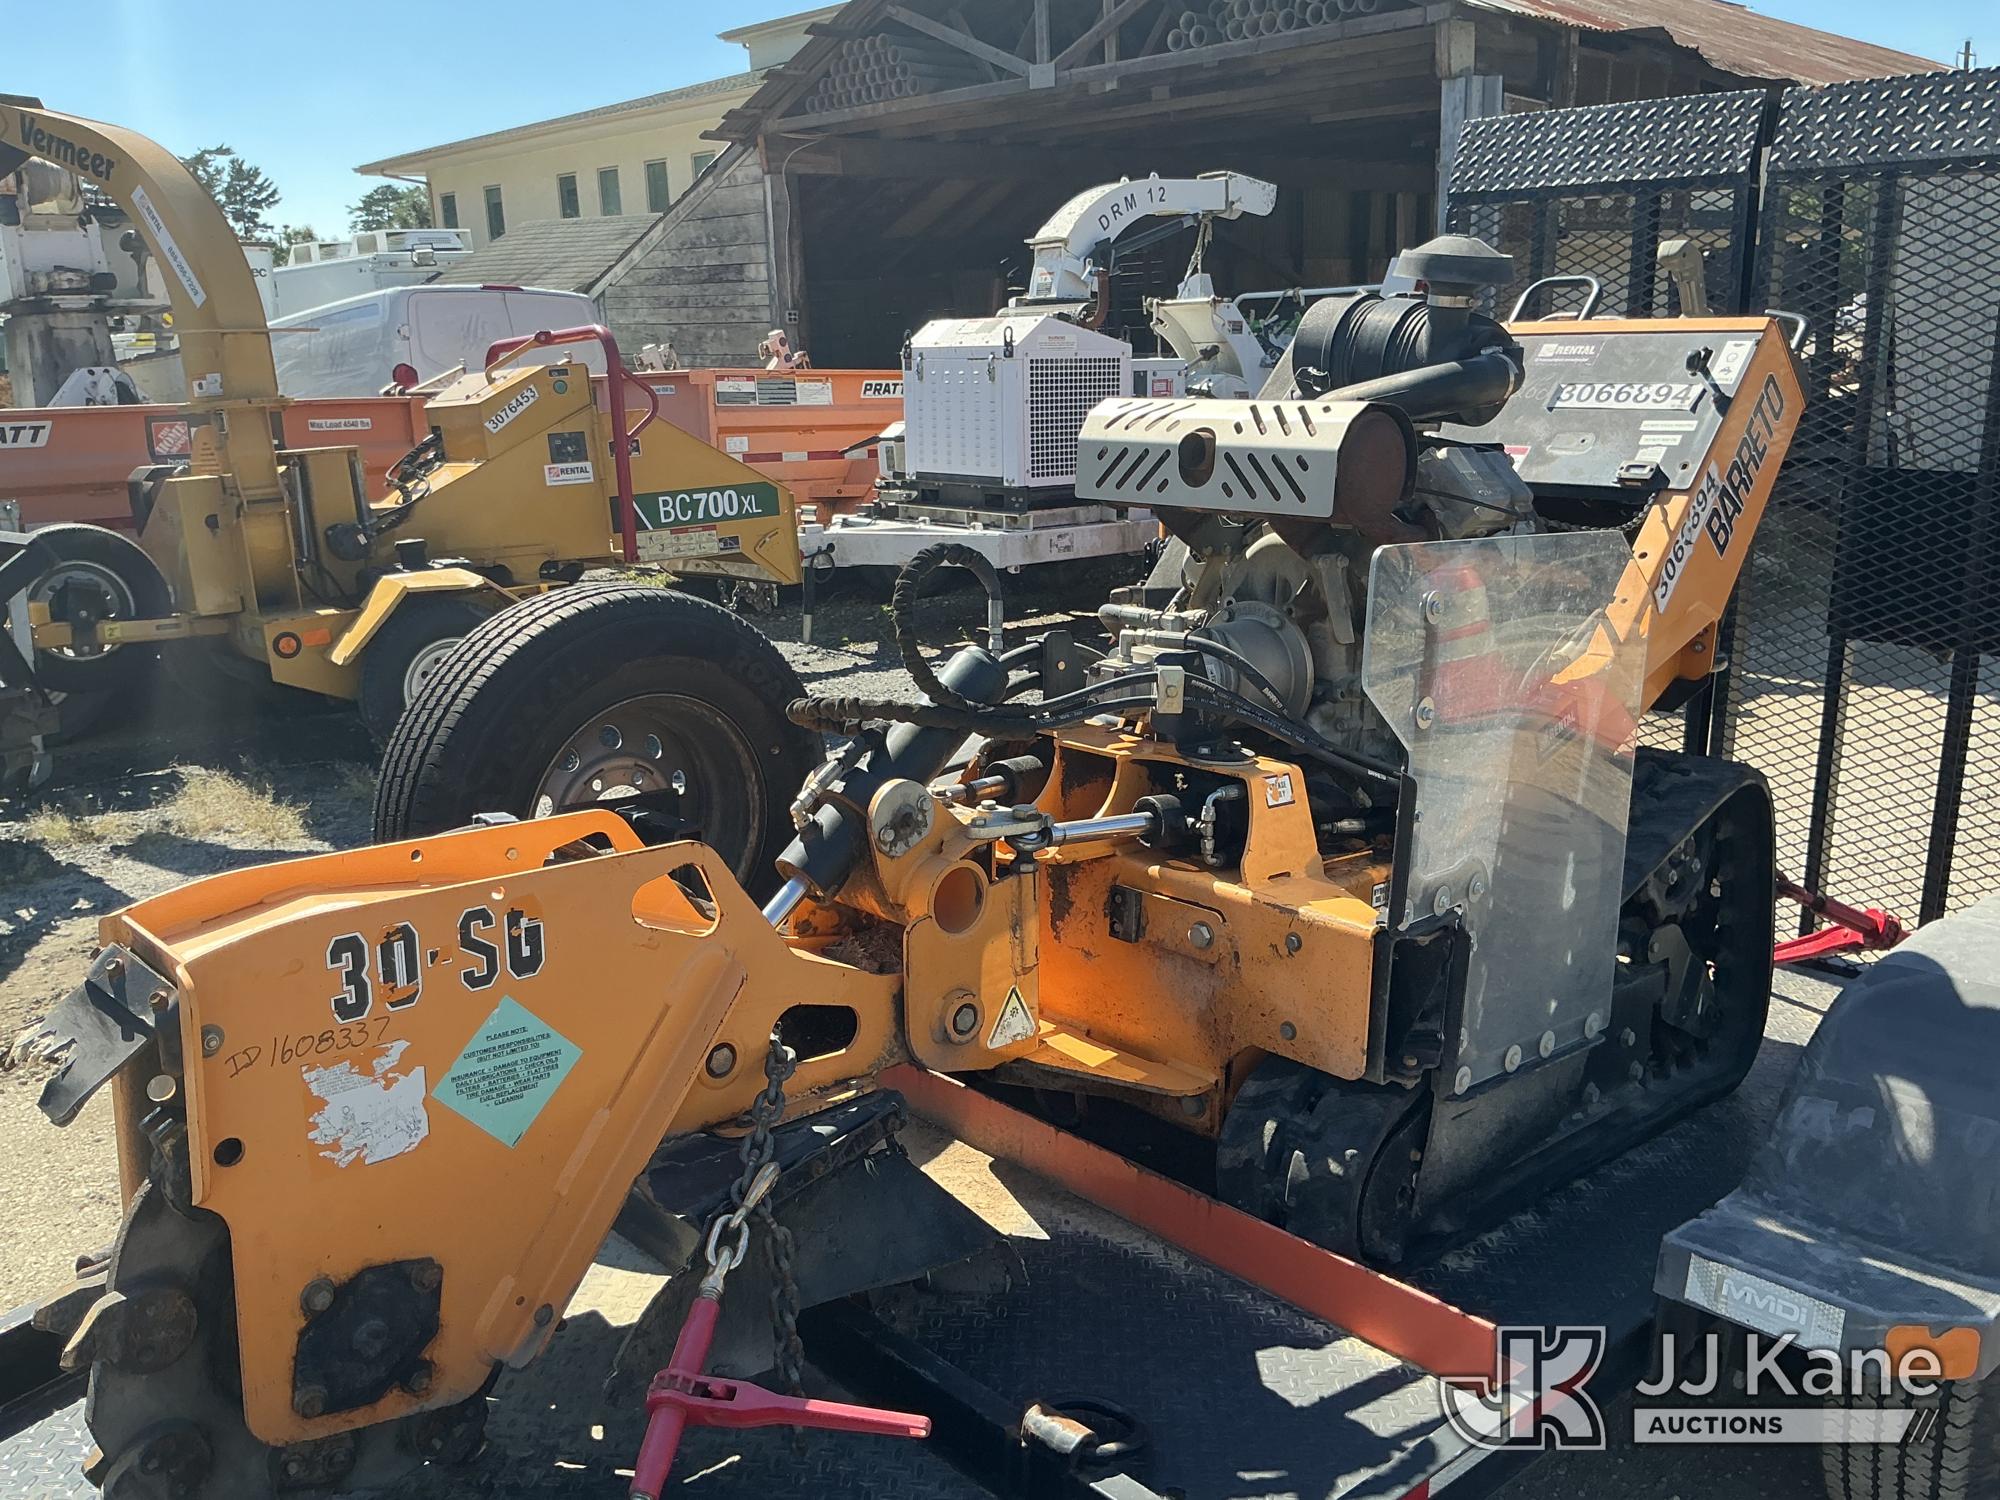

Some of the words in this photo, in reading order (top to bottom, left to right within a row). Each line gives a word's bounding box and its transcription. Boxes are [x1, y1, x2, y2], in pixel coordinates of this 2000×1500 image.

[19, 112, 115, 181] Vermeer
[1098, 193, 1138, 231] DRM
[1148, 186, 1166, 203] 12
[1556, 345, 1597, 355] RENTAL
[1560, 383, 1694, 404] 3066894
[488, 387, 536, 430] 3076453
[560, 466, 590, 475] RENTAL
[1704, 372, 1784, 560] BARRETO
[486, 1029, 510, 1041] PLEASE
[224, 1046, 262, 1078] ID
[270, 1016, 391, 1067] 1608337
[464, 1046, 497, 1059] CUSTOMER
[492, 1051, 505, 1059] NOT
[505, 1045, 529, 1056] LIMITED
[451, 1069, 485, 1082] INSURANCE
[493, 1060, 519, 1072] DAMAGE
[529, 1049, 562, 1062] EQUIPMENT
[524, 1061, 545, 1070] CHECK
[481, 1084, 508, 1095] DAMAGE
